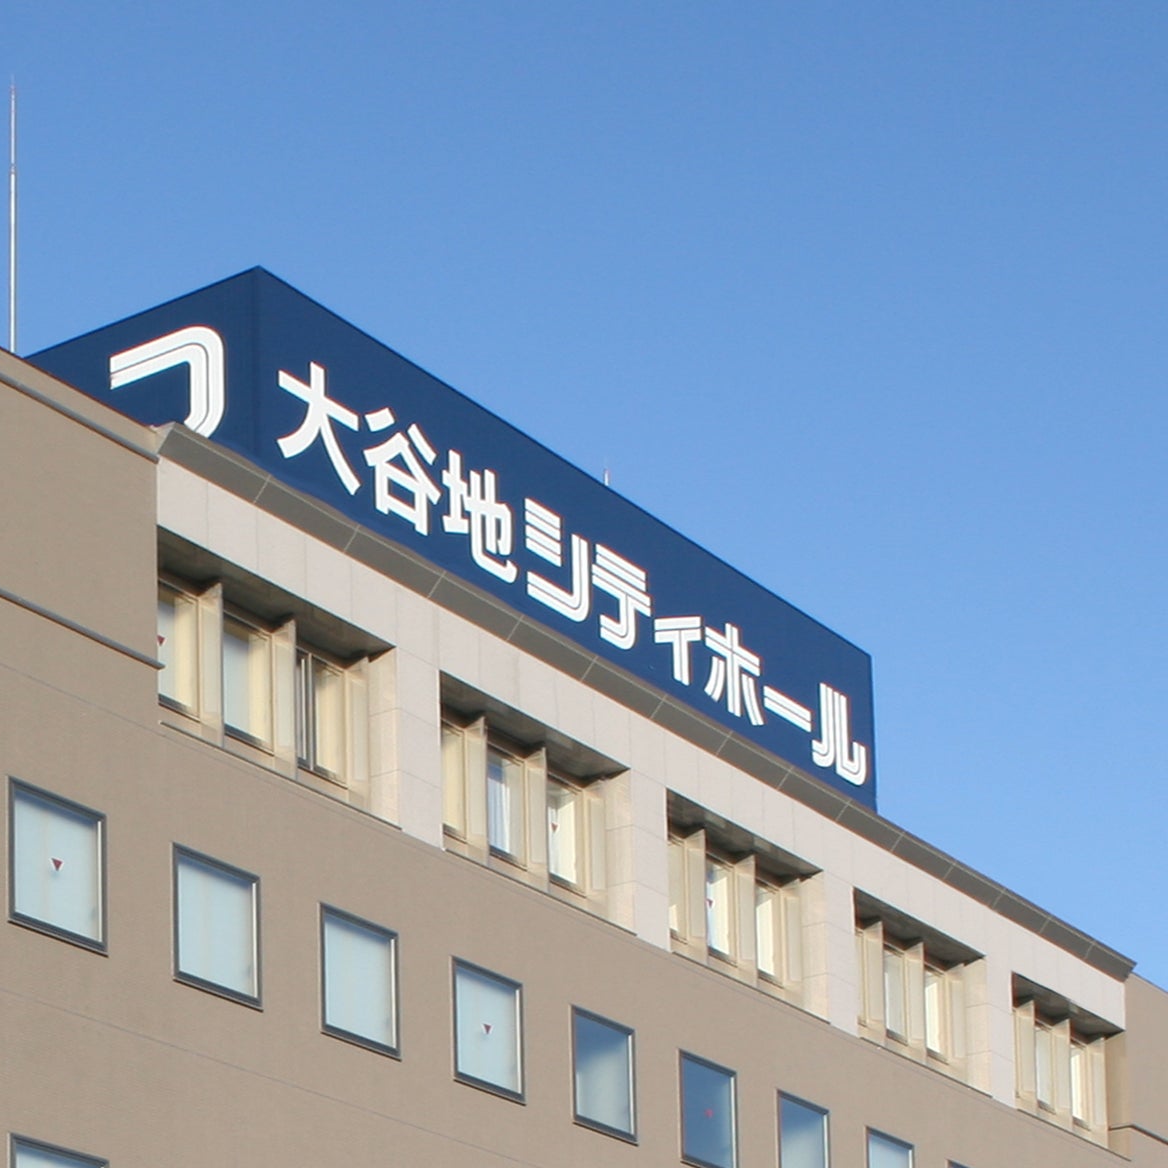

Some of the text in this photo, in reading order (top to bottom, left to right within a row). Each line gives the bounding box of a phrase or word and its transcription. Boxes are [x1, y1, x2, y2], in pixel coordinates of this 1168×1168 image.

[276, 360, 868, 787] 大谷地シティホール
